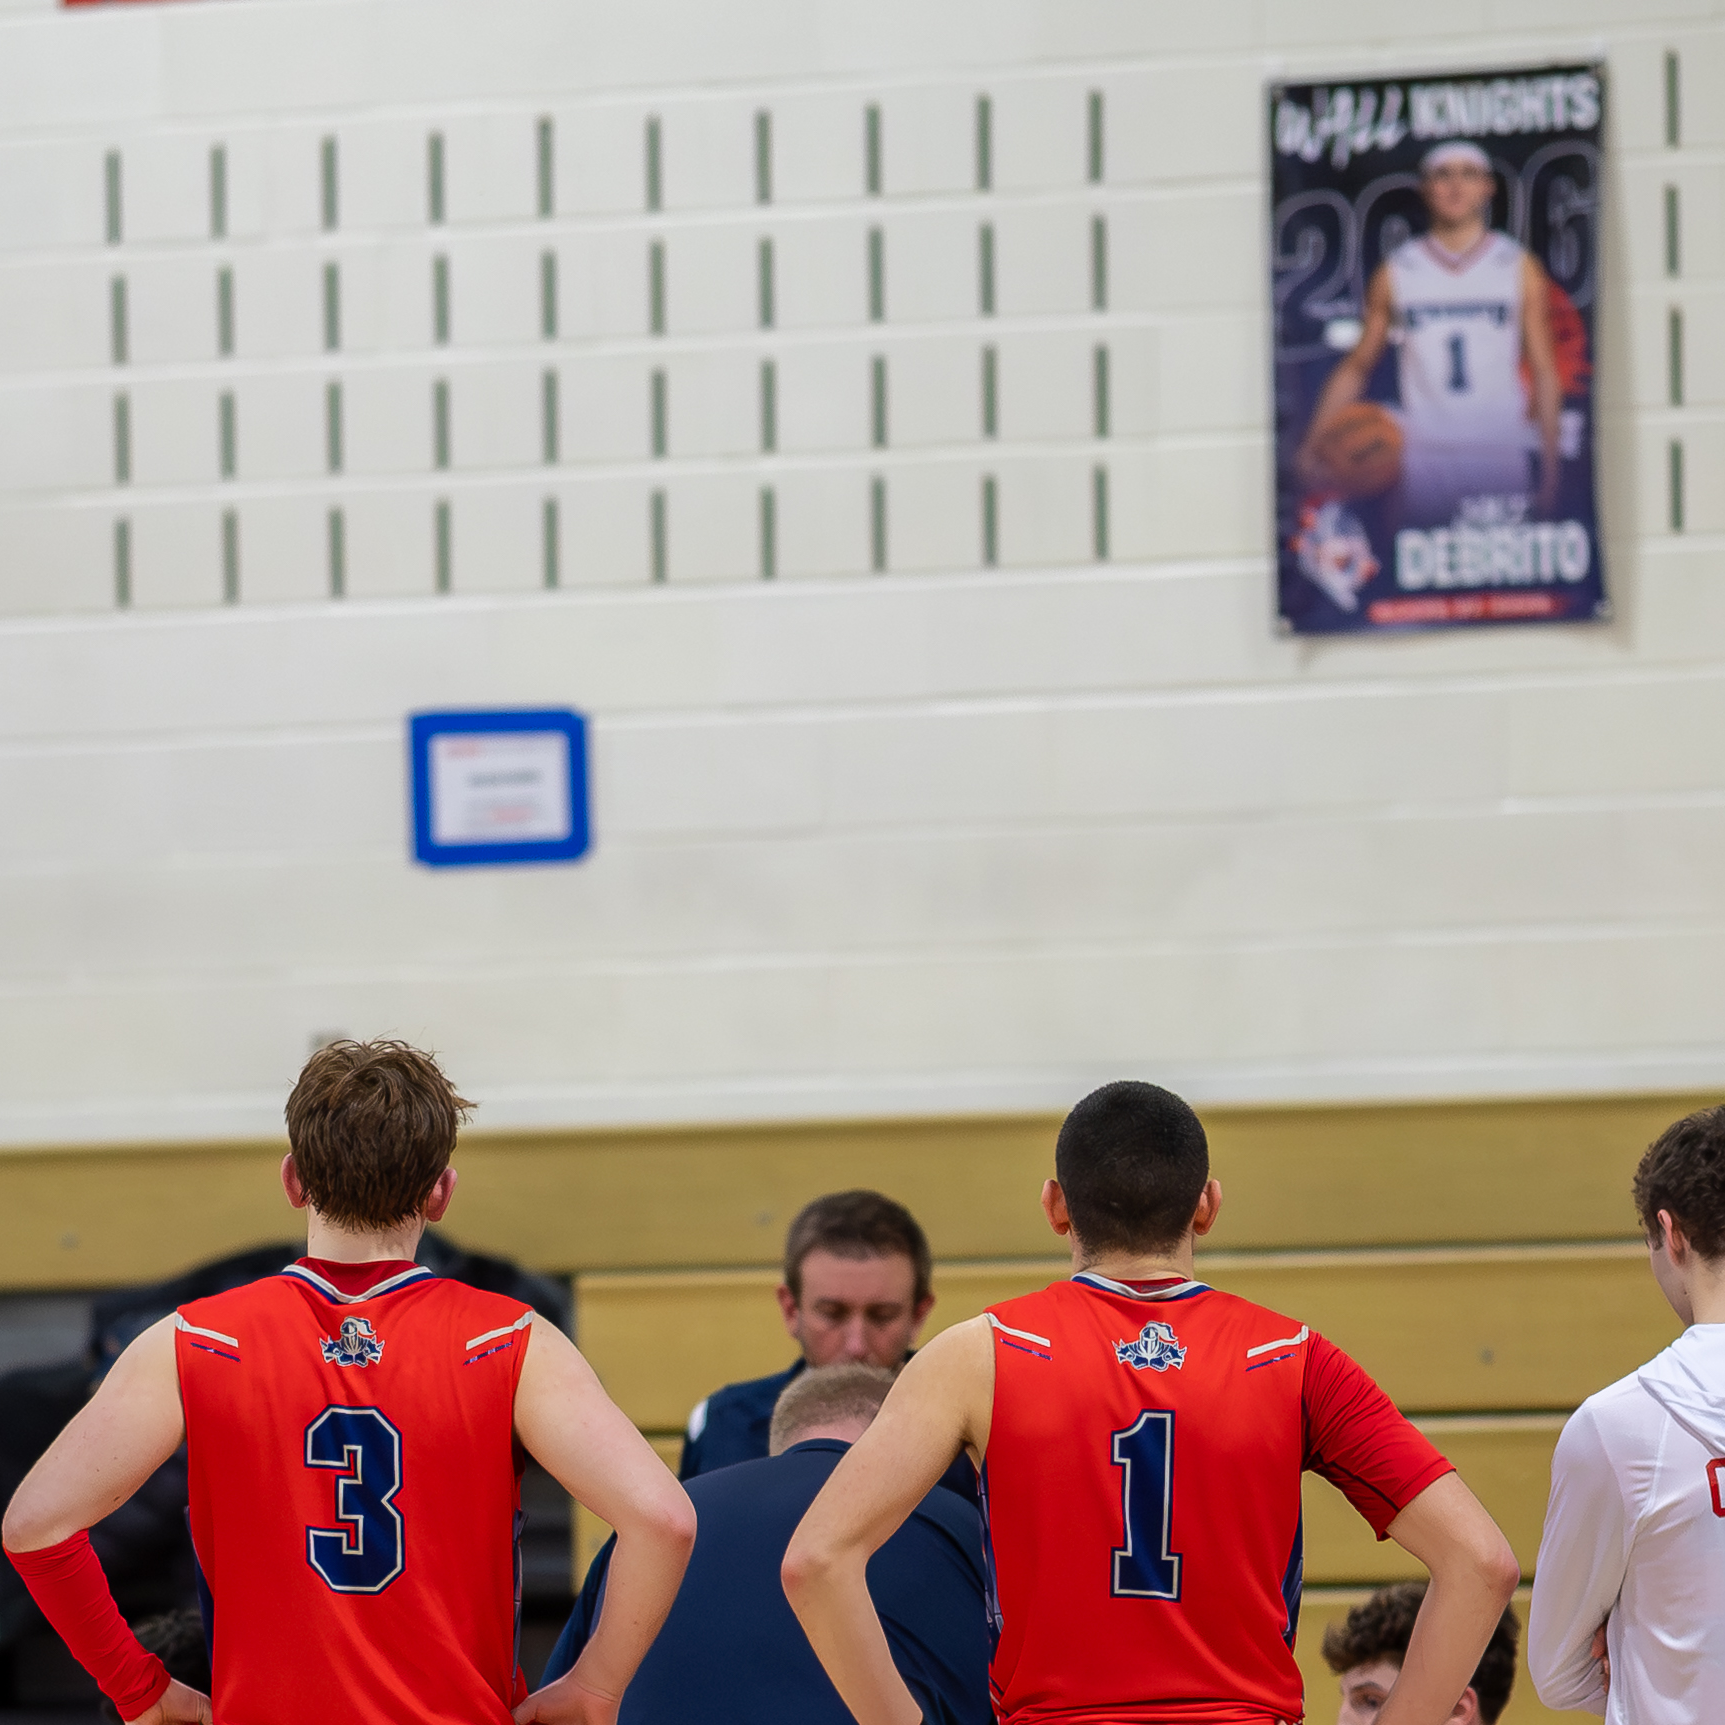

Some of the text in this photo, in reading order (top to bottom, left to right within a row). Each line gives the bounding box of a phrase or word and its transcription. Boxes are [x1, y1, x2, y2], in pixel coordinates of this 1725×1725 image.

[1408, 73, 1600, 140] KNIGHTS
[1447, 334, 1471, 393] 1
[1394, 519, 1590, 592] DEBRITO
[304, 1404, 406, 1596] 3
[1111, 1410, 1183, 1603] 1
